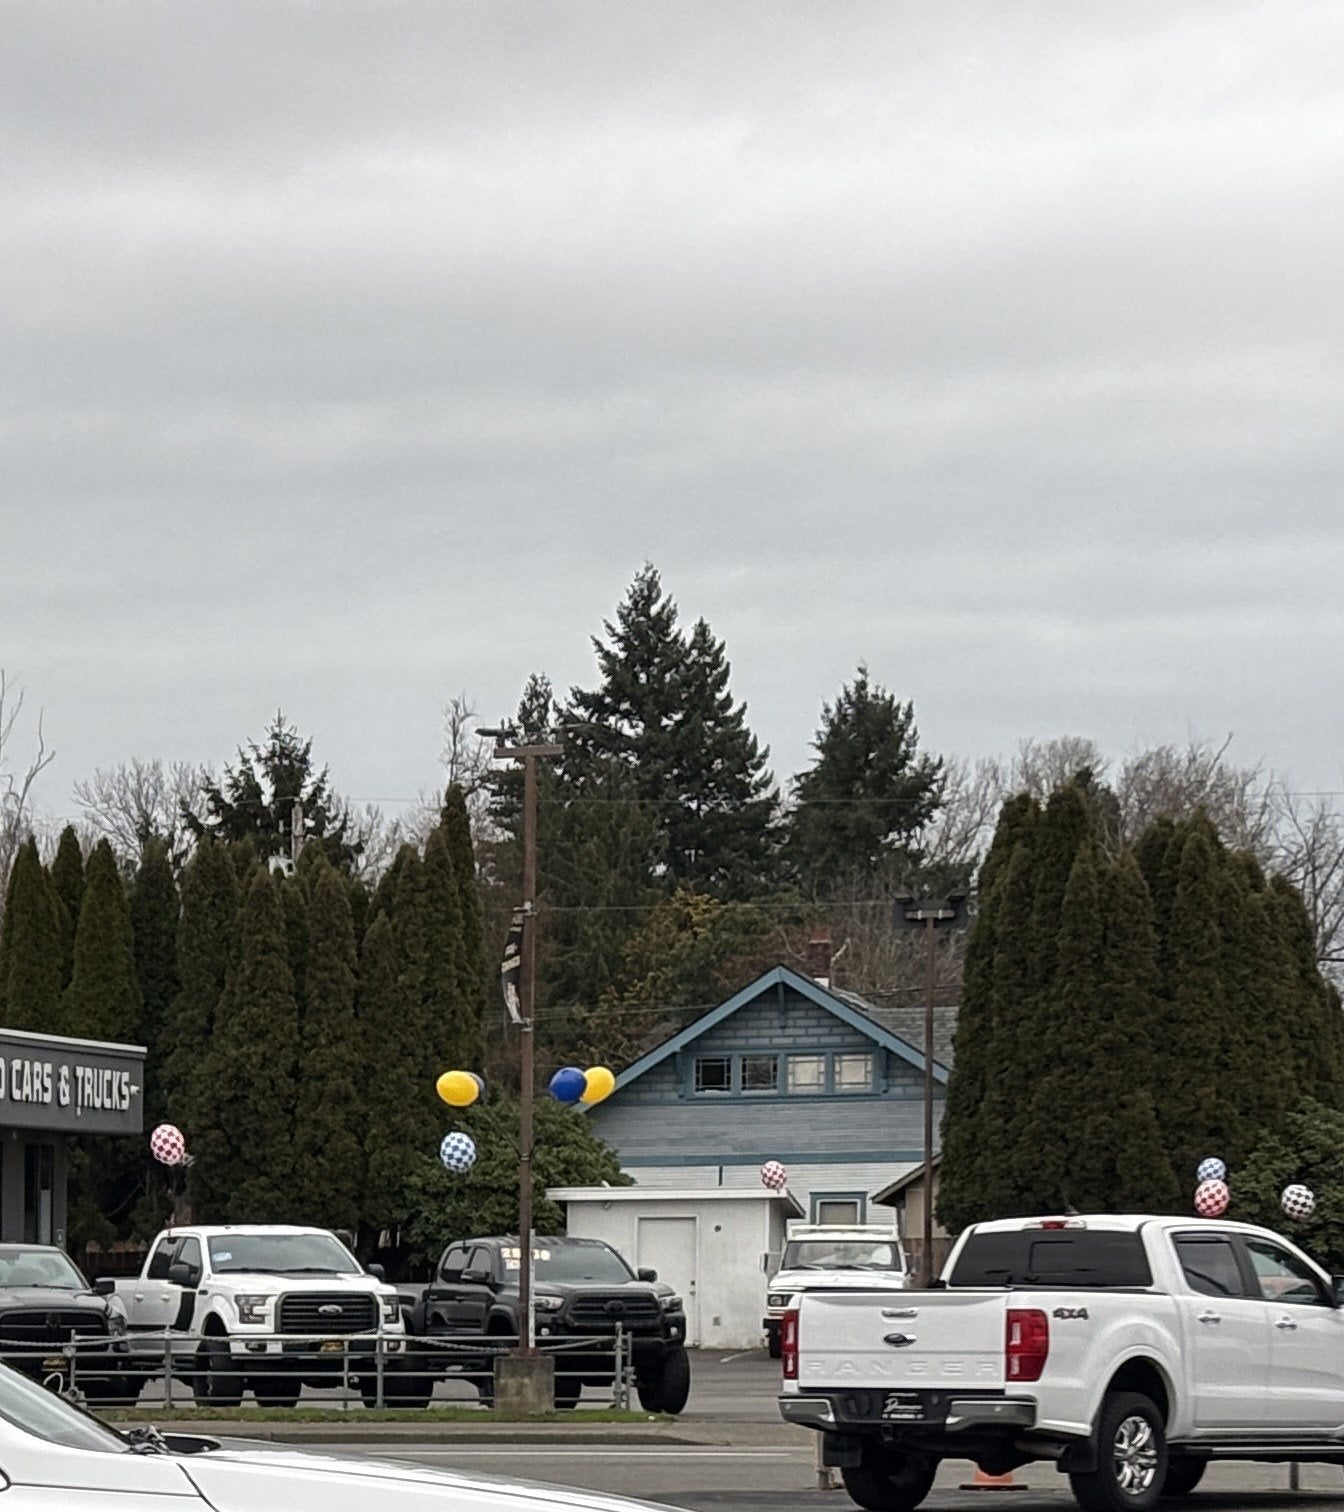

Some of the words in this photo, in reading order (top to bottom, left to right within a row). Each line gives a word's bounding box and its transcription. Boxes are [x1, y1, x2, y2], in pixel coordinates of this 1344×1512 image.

[12, 1059, 52, 1104] CARS
[58, 1065, 70, 1106] &
[76, 1066, 130, 1110] TRUCKS
[805, 1360, 998, 1377] RANGER
